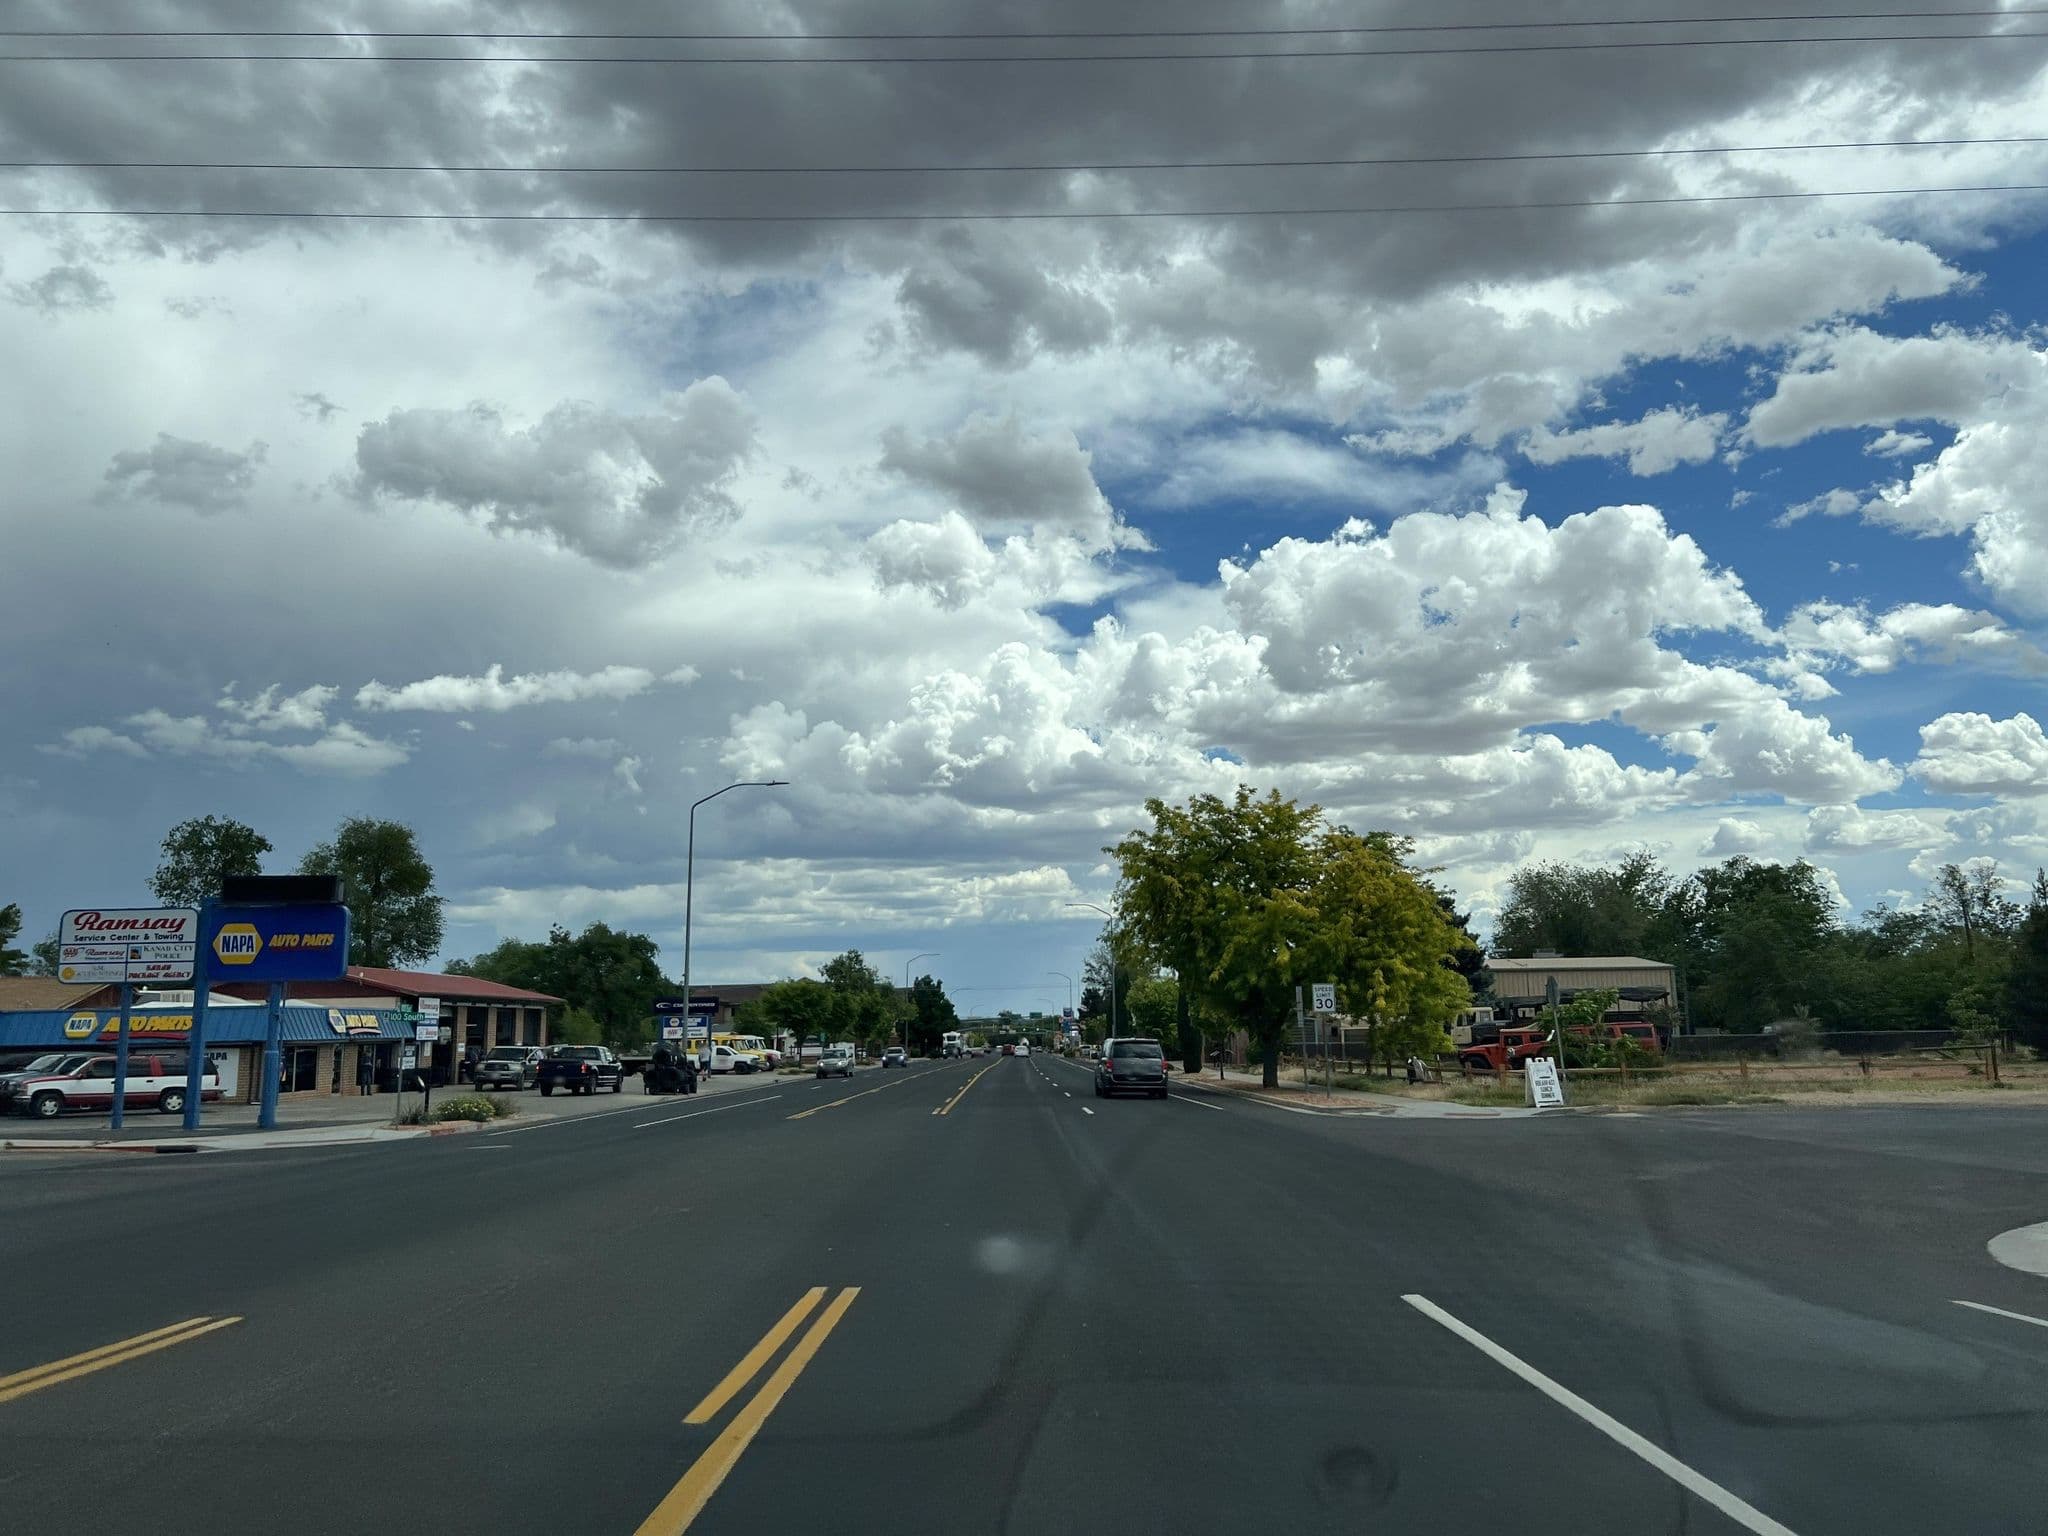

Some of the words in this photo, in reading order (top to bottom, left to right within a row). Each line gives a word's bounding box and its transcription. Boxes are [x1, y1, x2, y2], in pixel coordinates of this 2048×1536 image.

[74, 912, 186, 933] Ramsay
[74, 934, 106, 942] Service
[143, 933, 150, 941] &
[154, 933, 184, 941] Towing
[269, 934, 300, 947] AUTO
[301, 933, 335, 946] PARTS
[221, 935, 254, 953] NAPA
[85, 948, 126, 957] Ramsay
[1316, 998, 1333, 1008] 30
[101, 1016, 147, 1031] ATO
[144, 1015, 193, 1031] PARTS
[402, 1013, 424, 1021] South
[70, 1018, 92, 1030] NAPA
